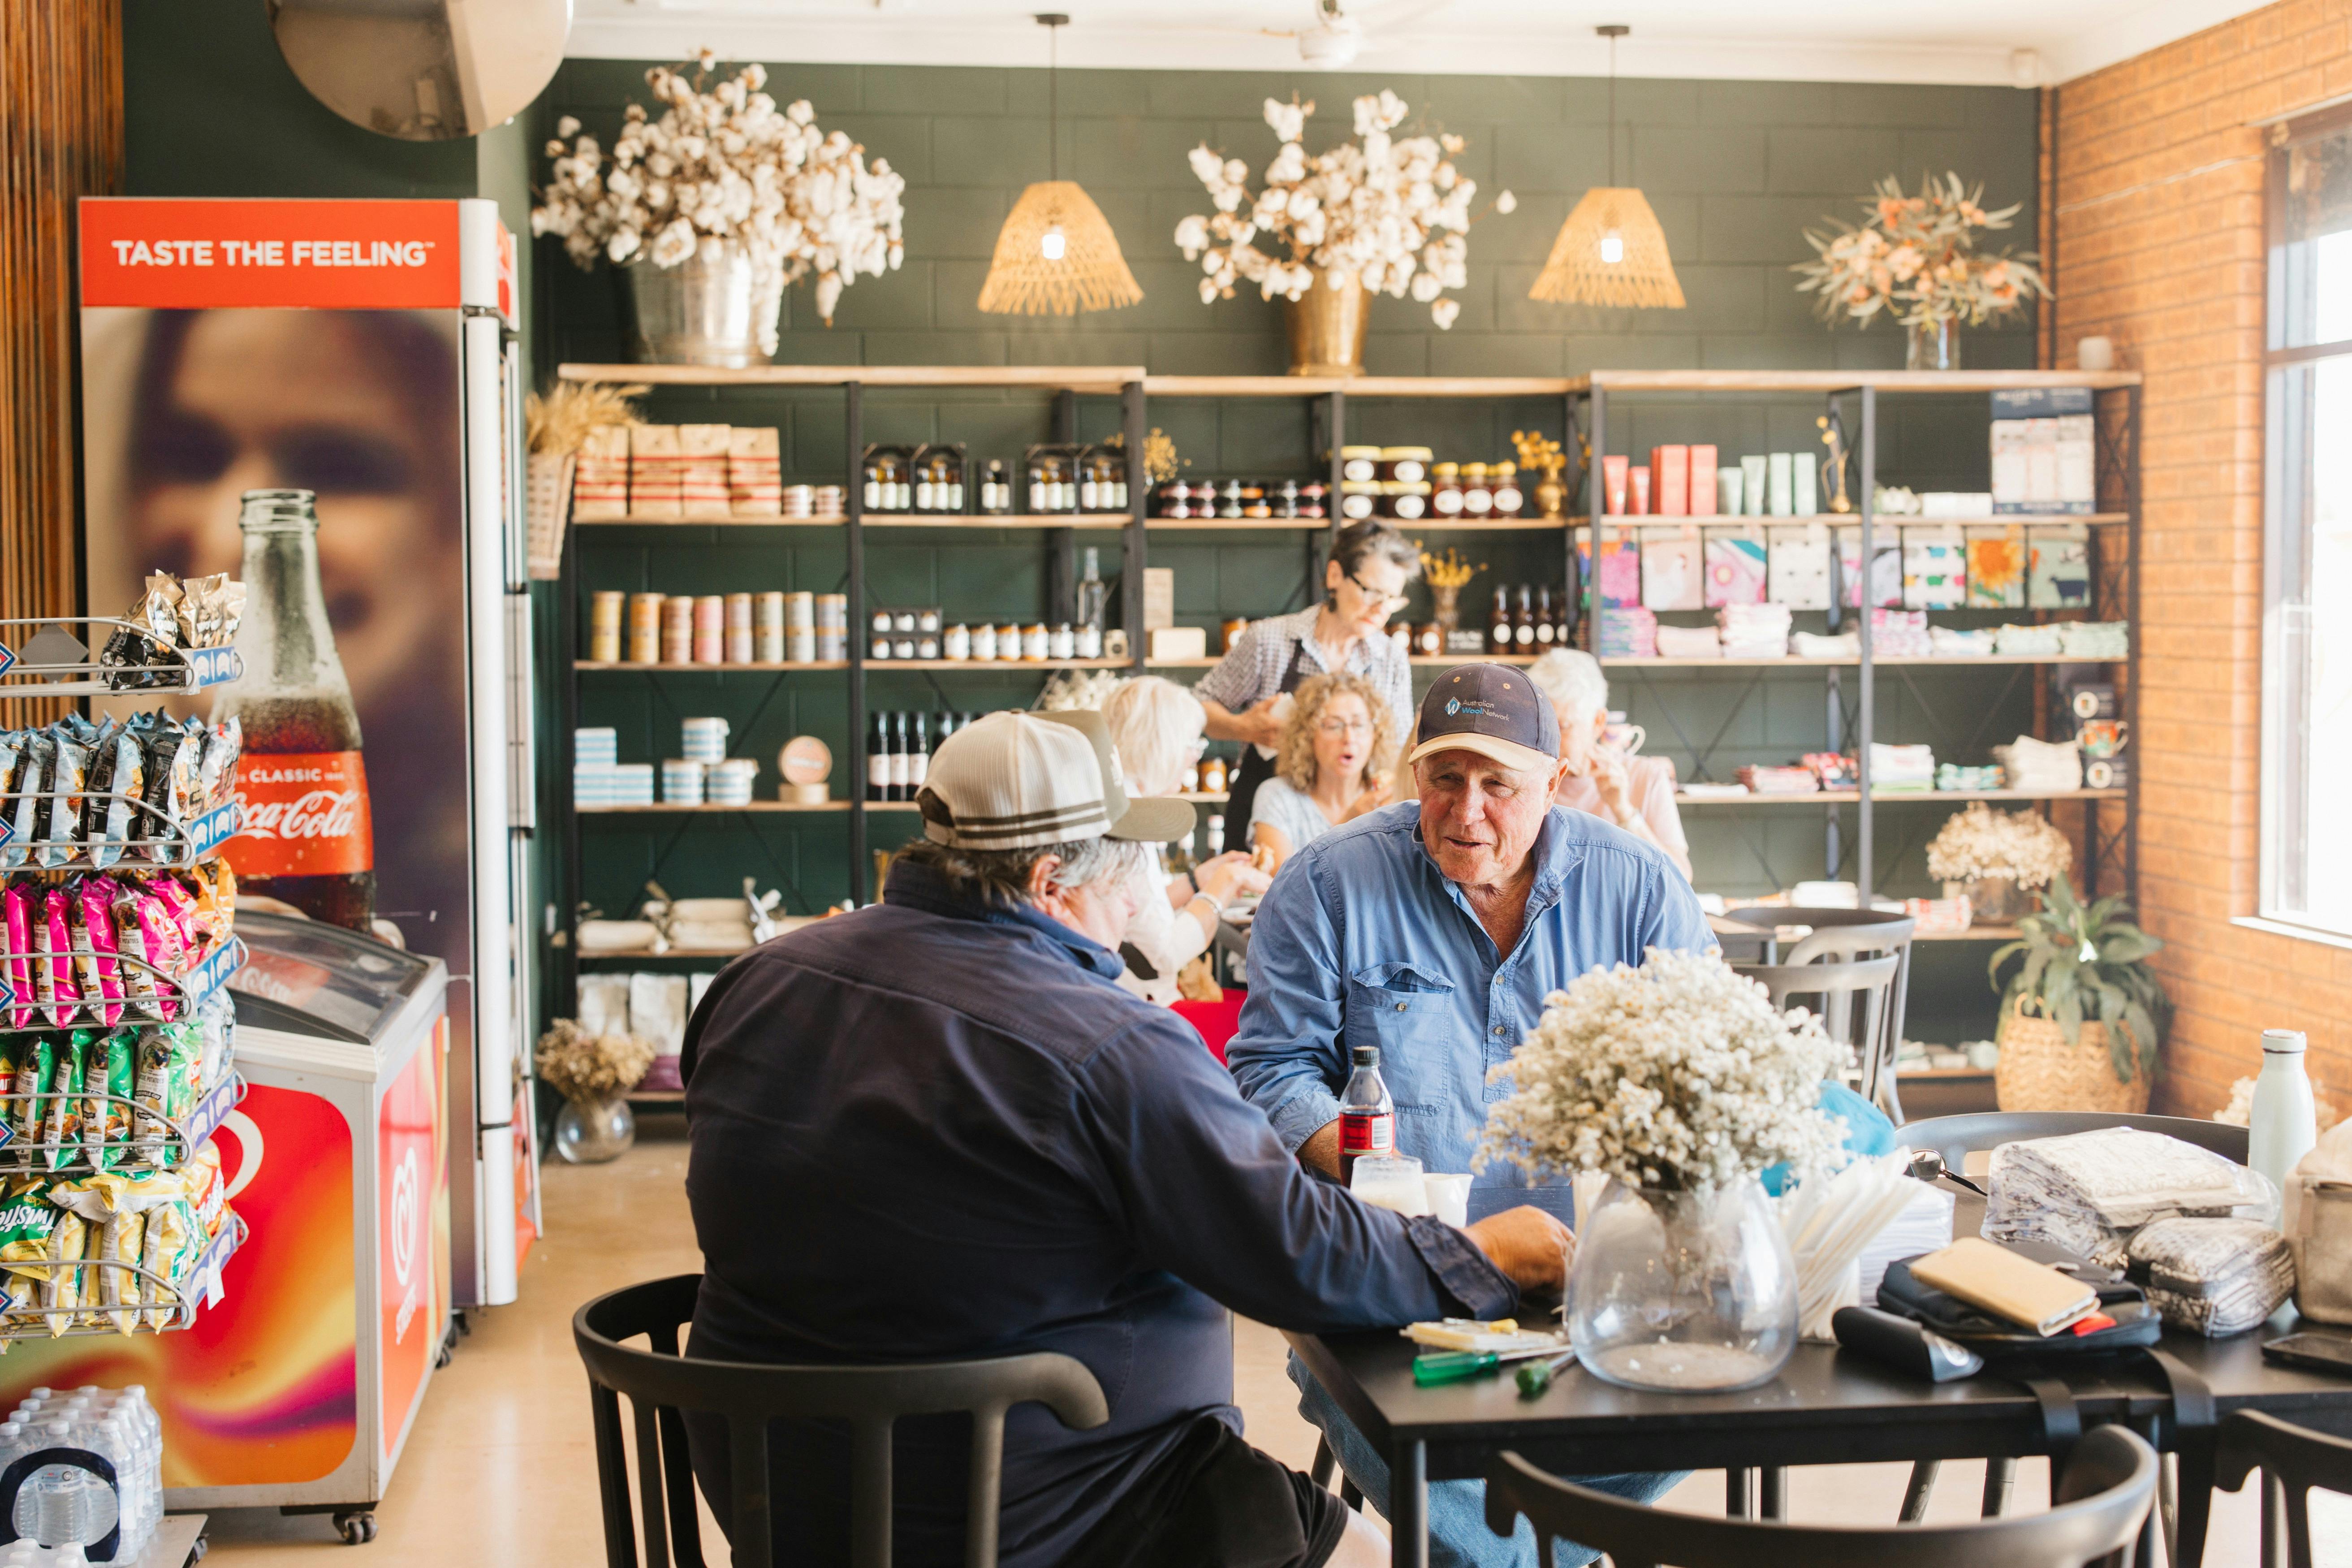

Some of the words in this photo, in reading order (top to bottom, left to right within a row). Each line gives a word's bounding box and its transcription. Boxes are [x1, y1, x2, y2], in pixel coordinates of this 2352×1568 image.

[111, 240, 214, 267] TASTE
[220, 241, 285, 267] THE
[1462, 699, 1494, 708] Australian
[249, 768, 322, 784] CLASSIC
[23, 1195, 54, 1207] Chicken
